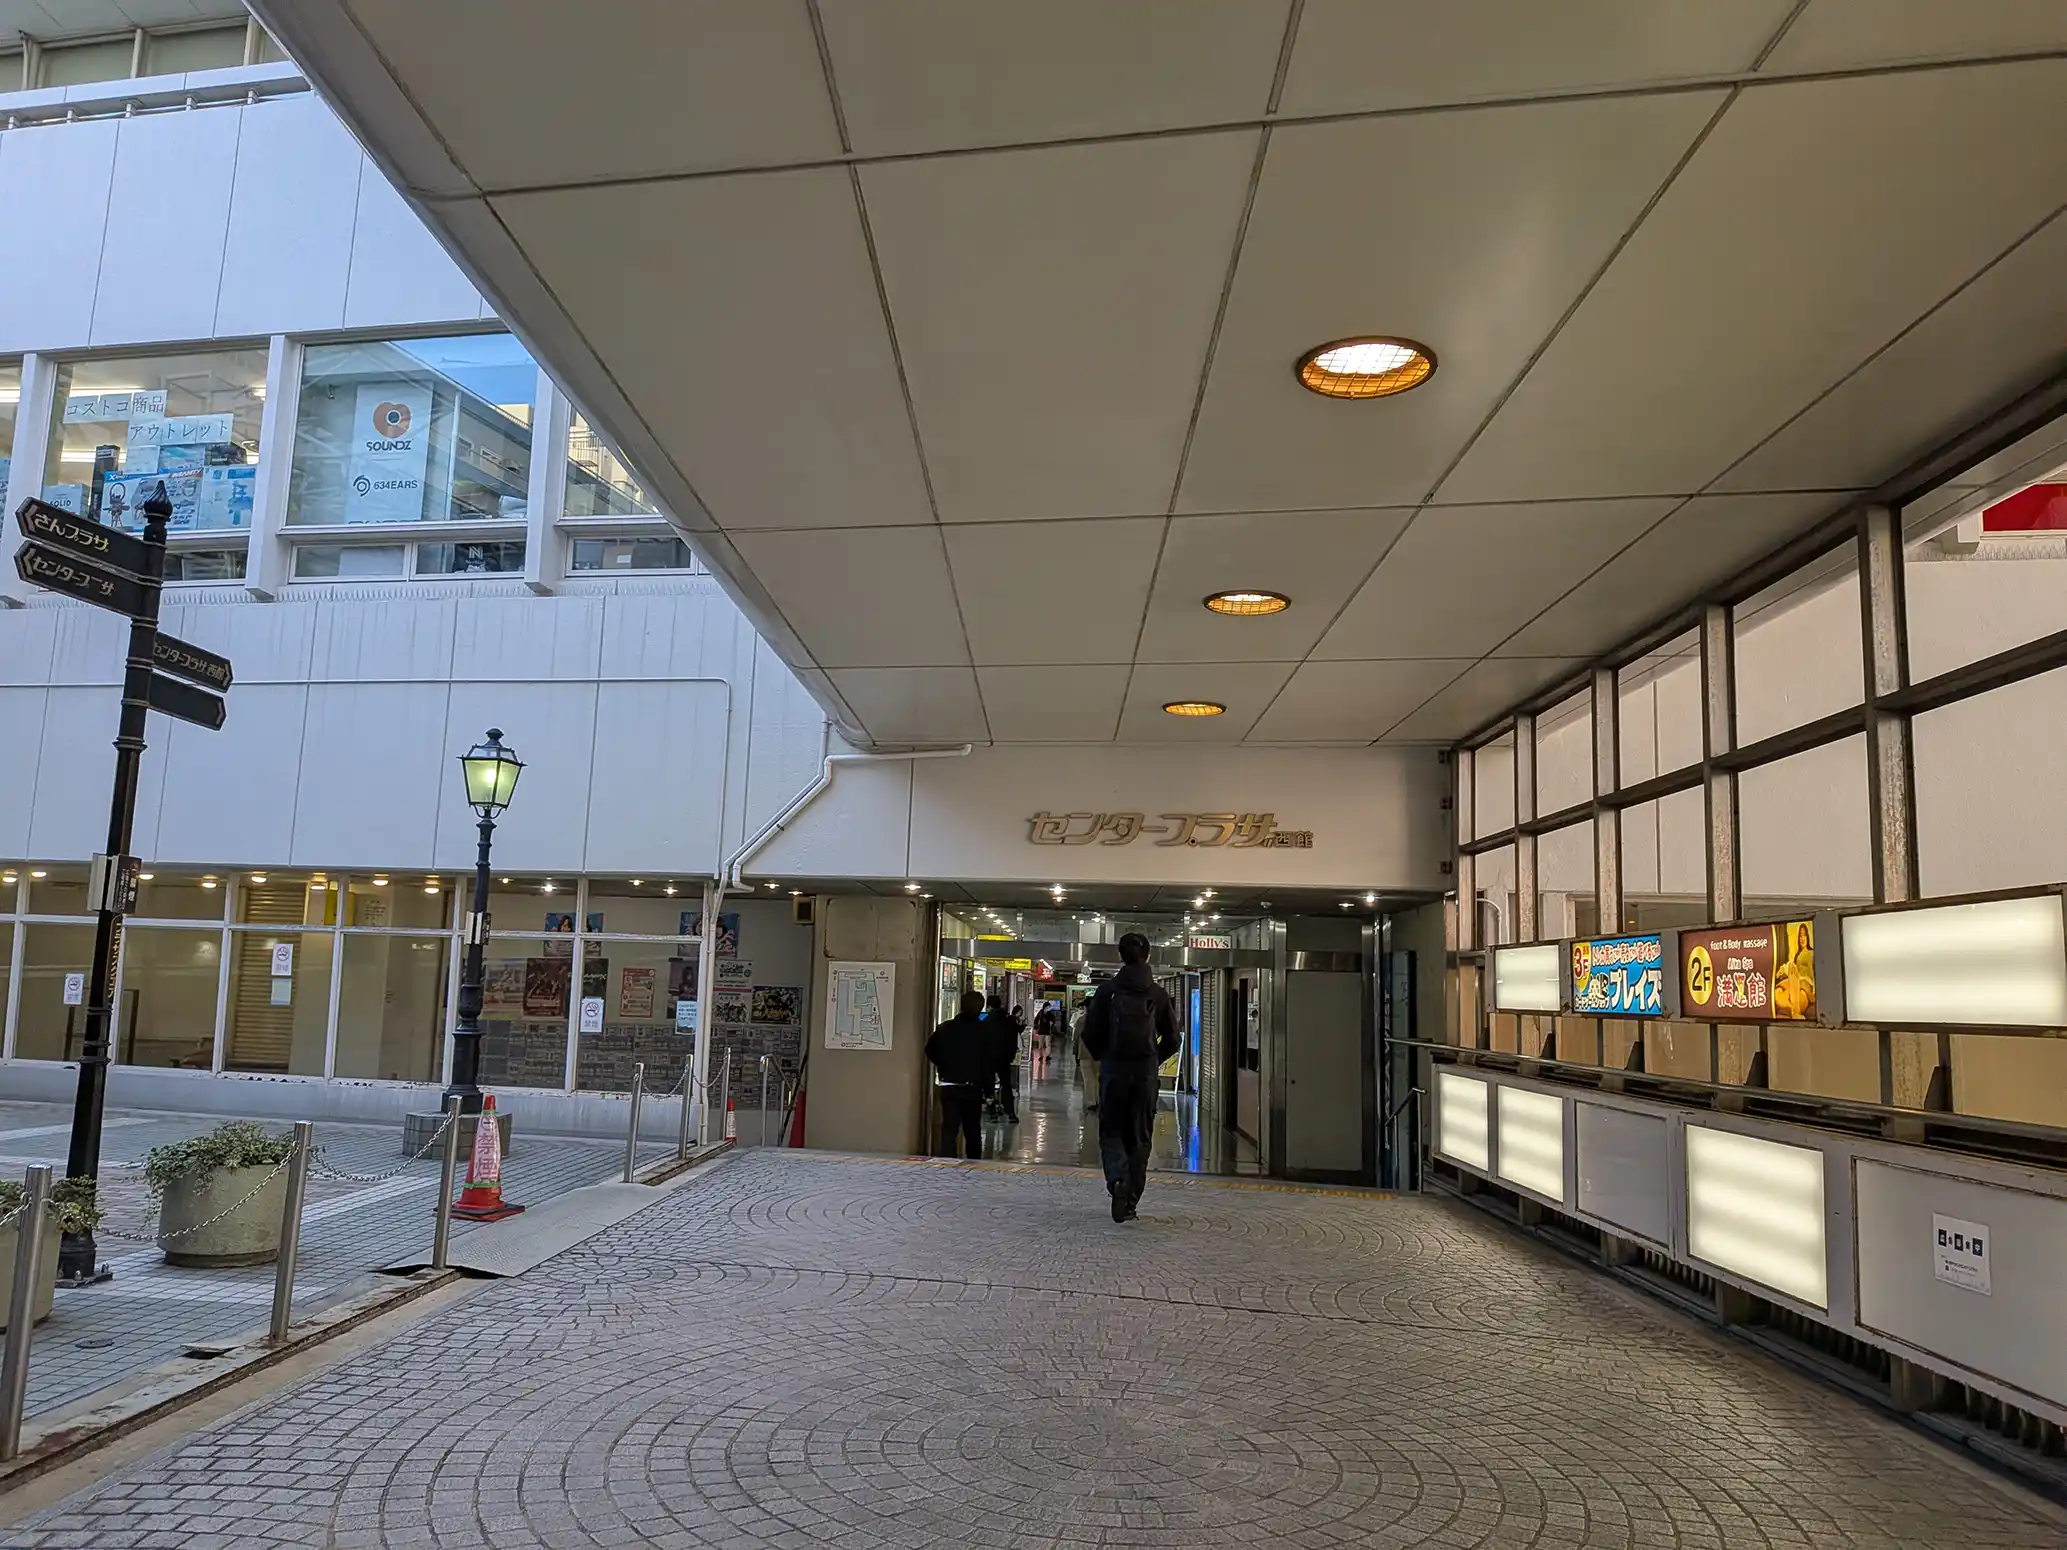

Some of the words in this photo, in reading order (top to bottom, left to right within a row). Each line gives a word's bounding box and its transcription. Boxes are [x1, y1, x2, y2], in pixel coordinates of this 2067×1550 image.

[67, 392, 164, 416] コストコ商品
[130, 420, 228, 442] アウトレット
[373, 480, 418, 490] 634EARS
[34, 512, 109, 553] さんプラザ
[1691, 957, 1711, 992] 2F
[1609, 967, 1662, 1012] プレイズ
